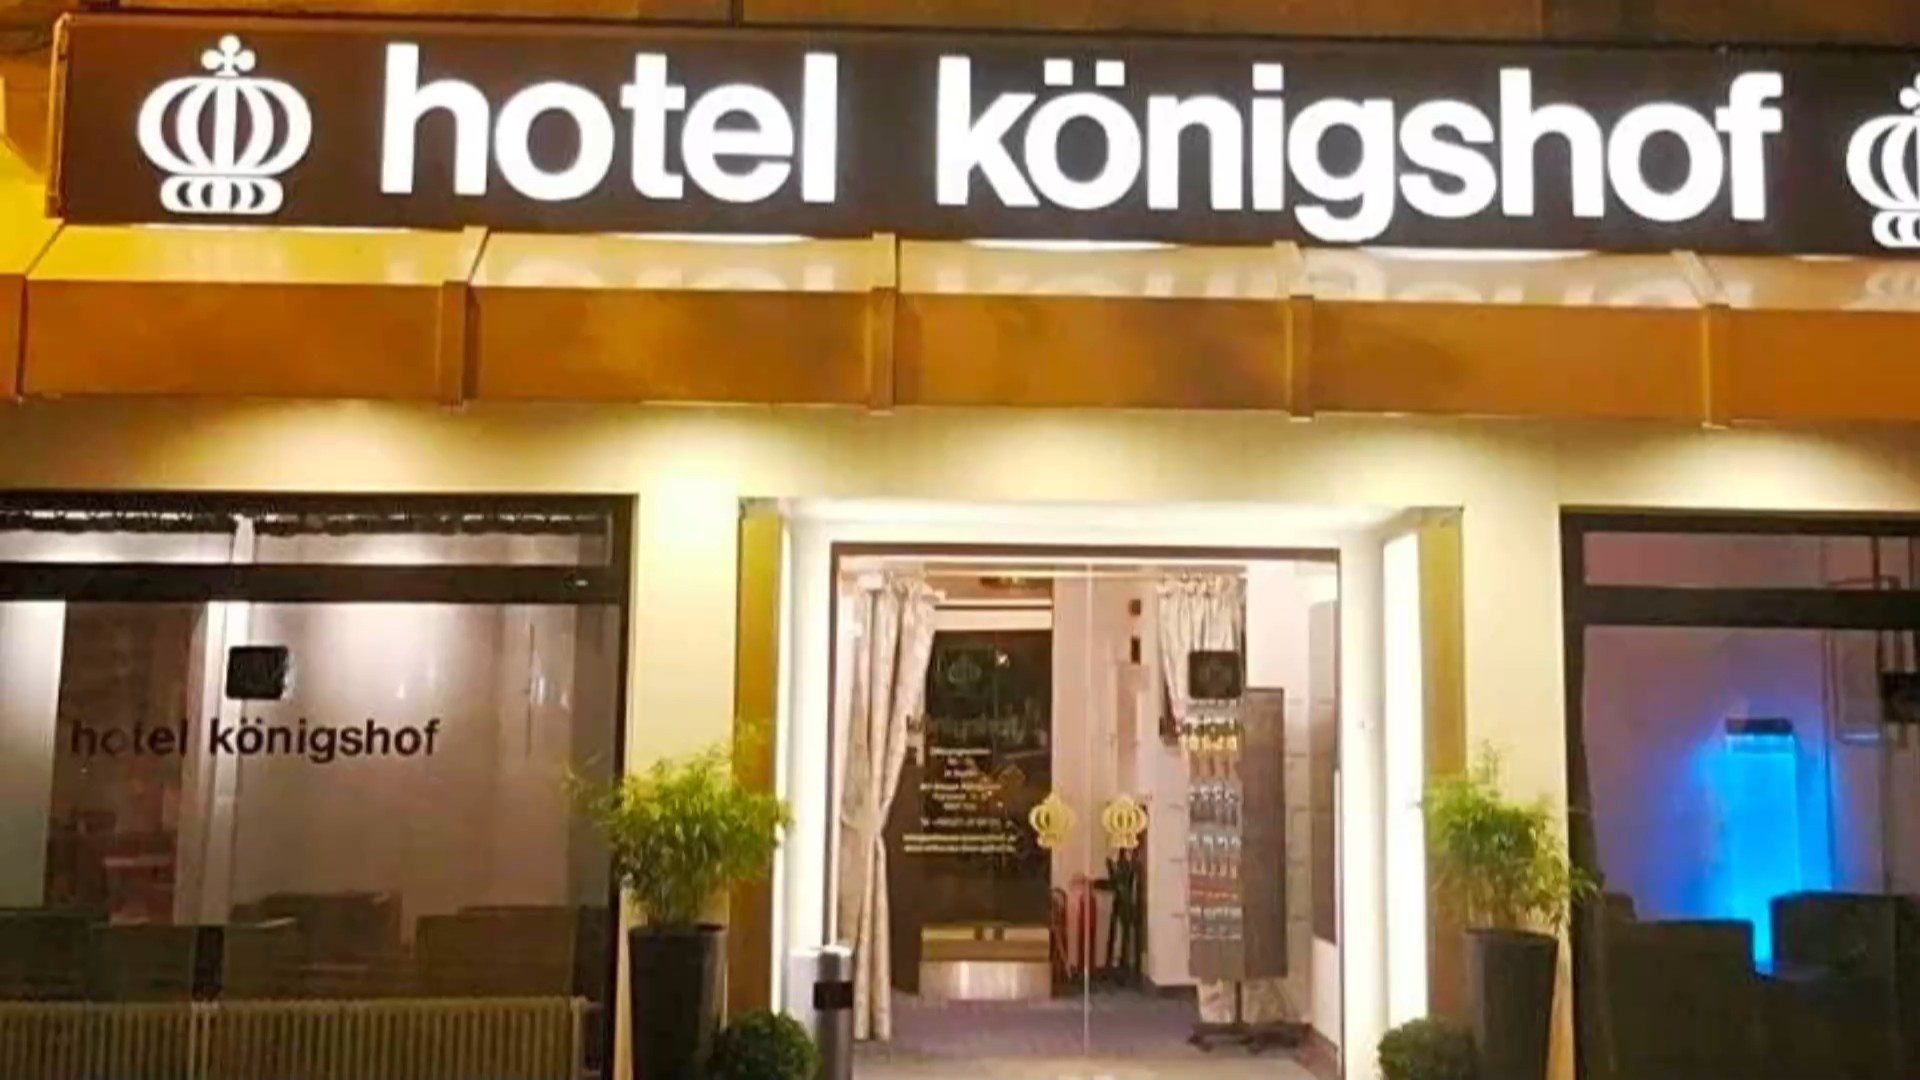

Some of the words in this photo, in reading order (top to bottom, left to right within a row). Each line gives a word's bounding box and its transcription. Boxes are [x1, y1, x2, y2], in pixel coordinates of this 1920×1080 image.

[381, 42, 838, 203] hotel
[936, 56, 1783, 243] königshof
[70, 718, 188, 756] hotel
[209, 717, 440, 764] königshof
